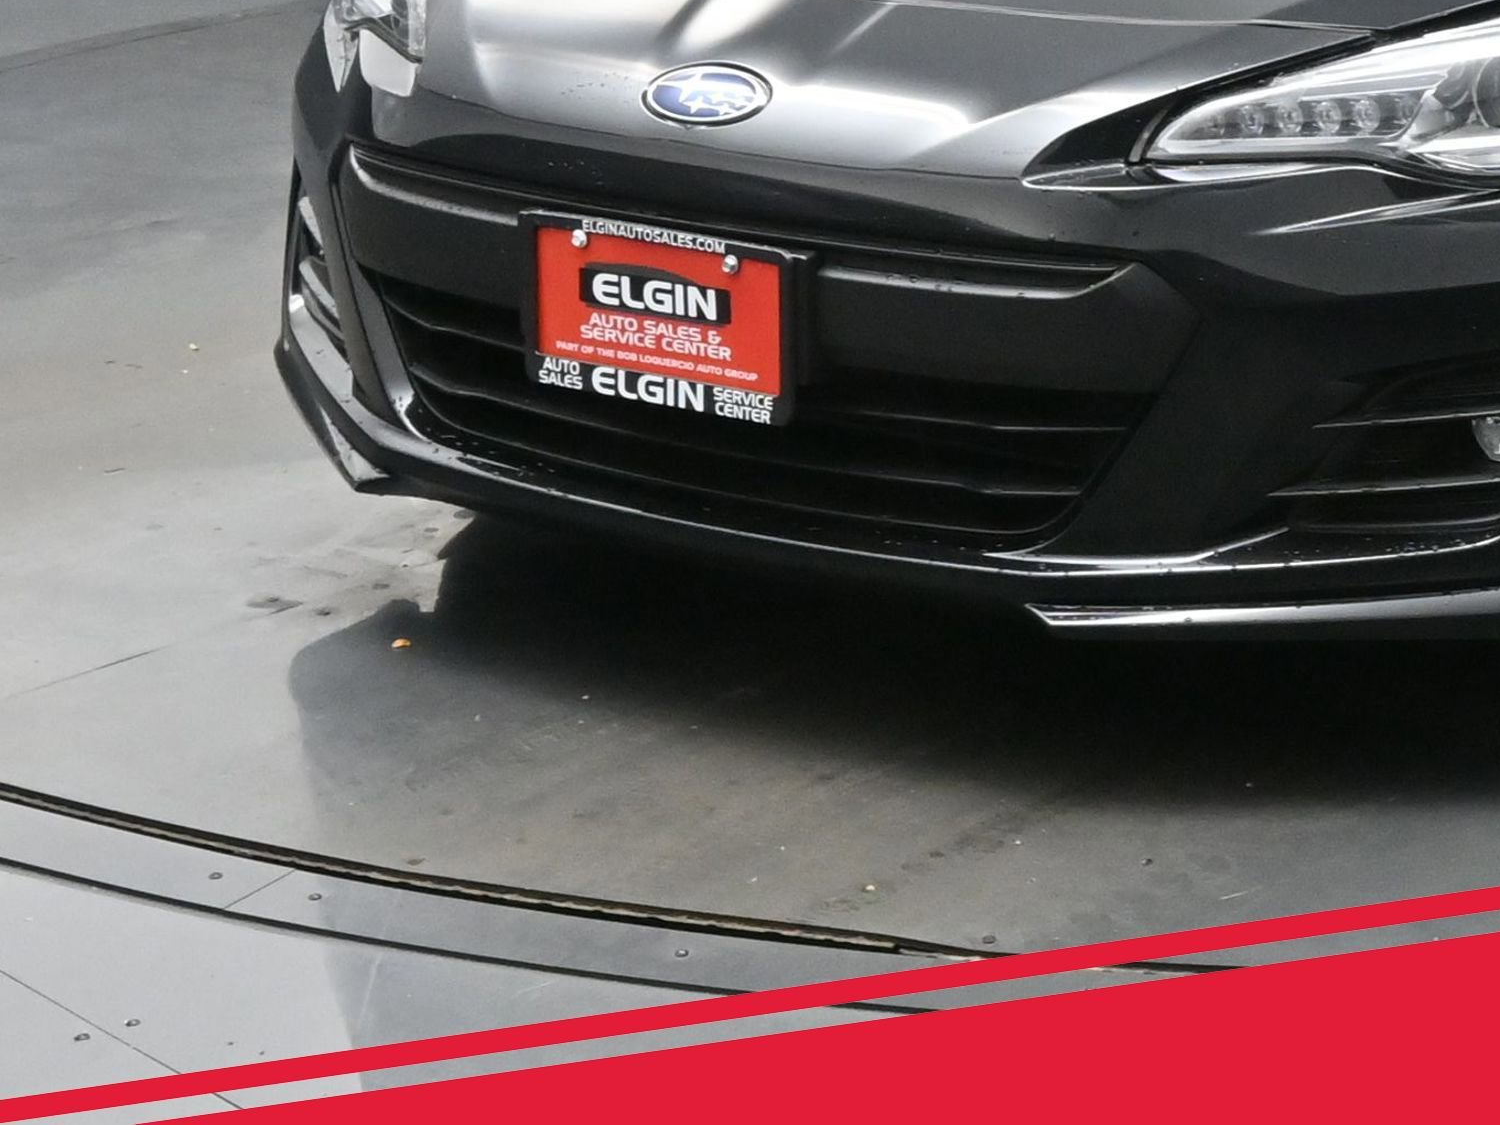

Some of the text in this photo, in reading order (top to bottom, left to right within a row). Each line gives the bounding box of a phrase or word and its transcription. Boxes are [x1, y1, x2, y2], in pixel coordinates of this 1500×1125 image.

[581, 219, 726, 254] ELGINAUTOSALES.COM
[592, 272, 717, 321] ELGIN
[580, 325, 732, 361] SERVICE CENTER
[588, 312, 722, 344] AUTO SALES &
[542, 356, 580, 375] AUTO
[555, 340, 579, 352] PART
[581, 346, 595, 354] OF
[596, 347, 615, 358] THE
[617, 351, 638, 362] BOB
[696, 363, 723, 375] AUTO
[724, 368, 759, 382] GROUP
[538, 370, 583, 390] SALES
[591, 366, 705, 413] ELGIN
[713, 386, 774, 411] SERVICE
[714, 402, 771, 425] CENTER
